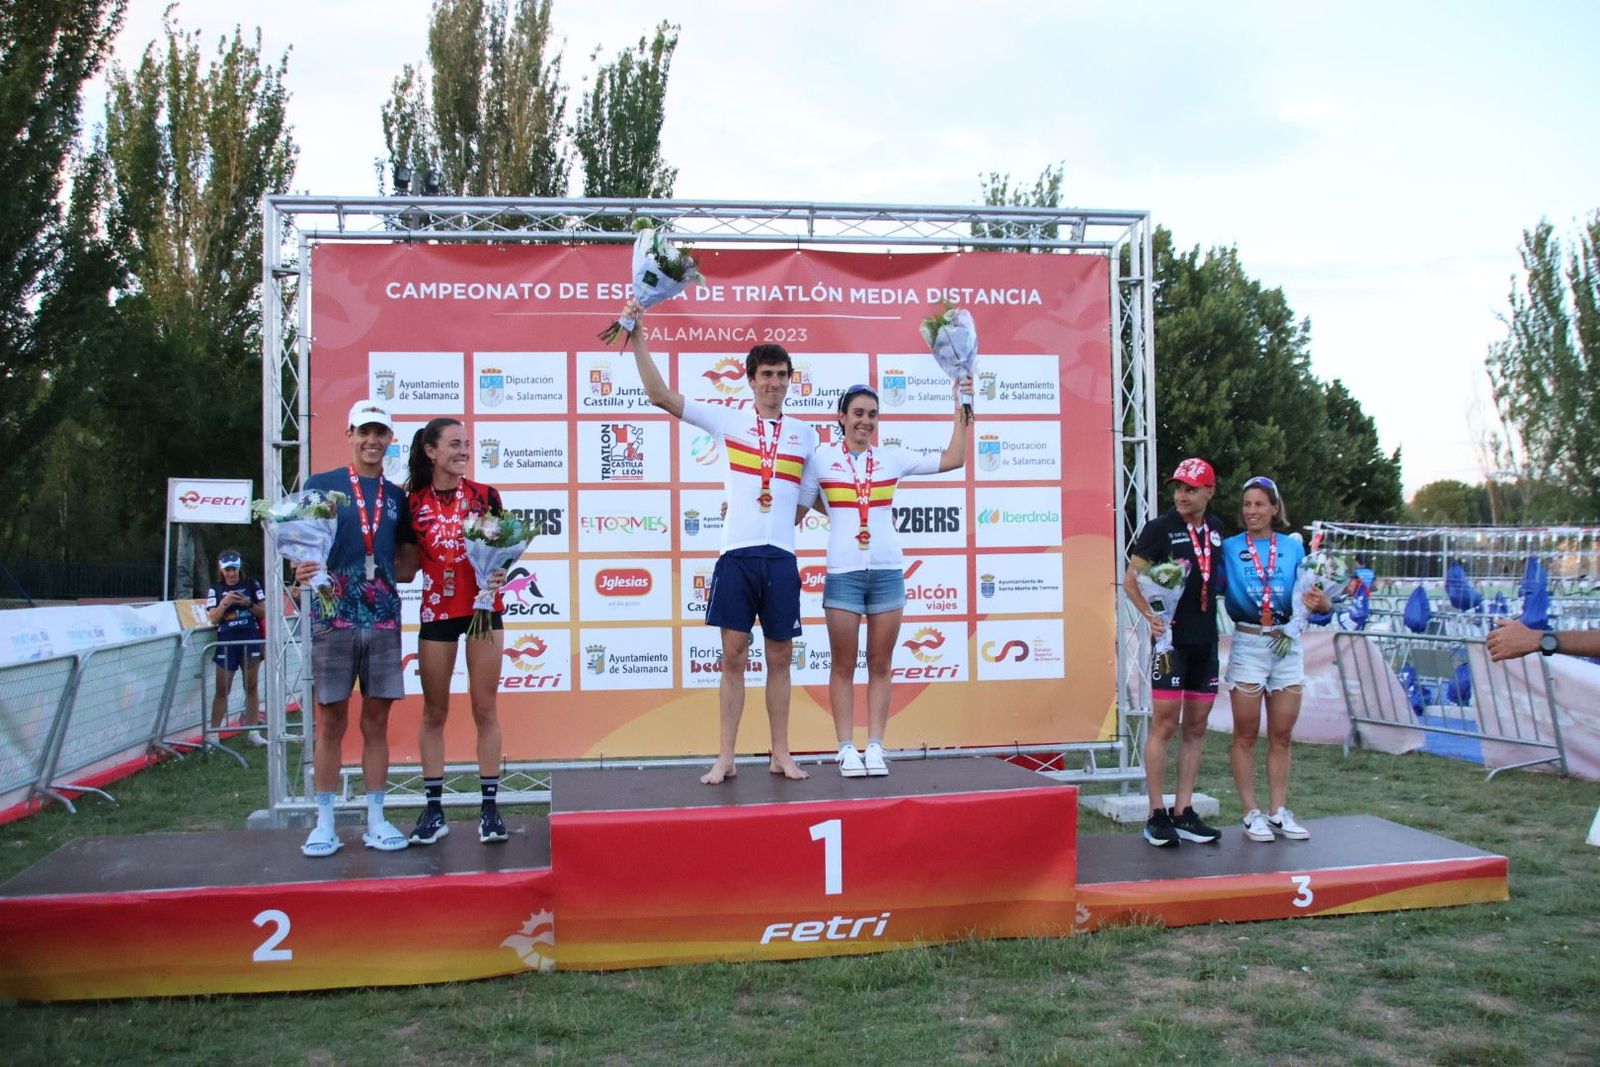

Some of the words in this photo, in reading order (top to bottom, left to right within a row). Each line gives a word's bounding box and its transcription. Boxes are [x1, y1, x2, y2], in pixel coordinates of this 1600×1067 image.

[385, 282, 551, 299] CAMPEONATO
[559, 283, 589, 299] DE
[695, 285, 725, 301] DE
[732, 281, 843, 302] TRIATLÓN
[850, 287, 919, 304] MEDIA
[926, 287, 1042, 305] DISTANCIA
[763, 328, 808, 342] 2023
[399, 379, 460, 391] Ayuntamiento
[505, 375, 554, 386] Diputación
[1000, 381, 1055, 391] Ayuntamiento
[399, 391, 410, 400] de
[412, 391, 460, 401] Salamanca
[516, 391, 563, 401] Salamanca
[1000, 391, 1010, 400] de
[1012, 391, 1055, 400] Salamanca
[583, 397, 624, 407] Castilla
[627, 399, 635, 408] y
[784, 398, 824, 407] Castilla
[827, 400, 834, 409] y
[1002, 441, 1047, 451] Diputación
[503, 448, 563, 459] Ayuntamiento
[600, 424, 611, 480] TRIATLON
[503, 458, 514, 468] de
[517, 458, 563, 468] Salamanca
[1012, 457, 1056, 465] Salamanca
[1003, 510, 1059, 523] Iberdrola
[906, 584, 957, 599] alcón
[926, 601, 957, 611] viajes
[609, 653, 668, 664] Ayuntamiento
[609, 665, 620, 674] de
[622, 664, 668, 674] Salamanca
[810, 660, 820, 670] de
[809, 819, 843, 895] 1
[1291, 875, 1314, 907] 3
[253, 909, 293, 961] 2
